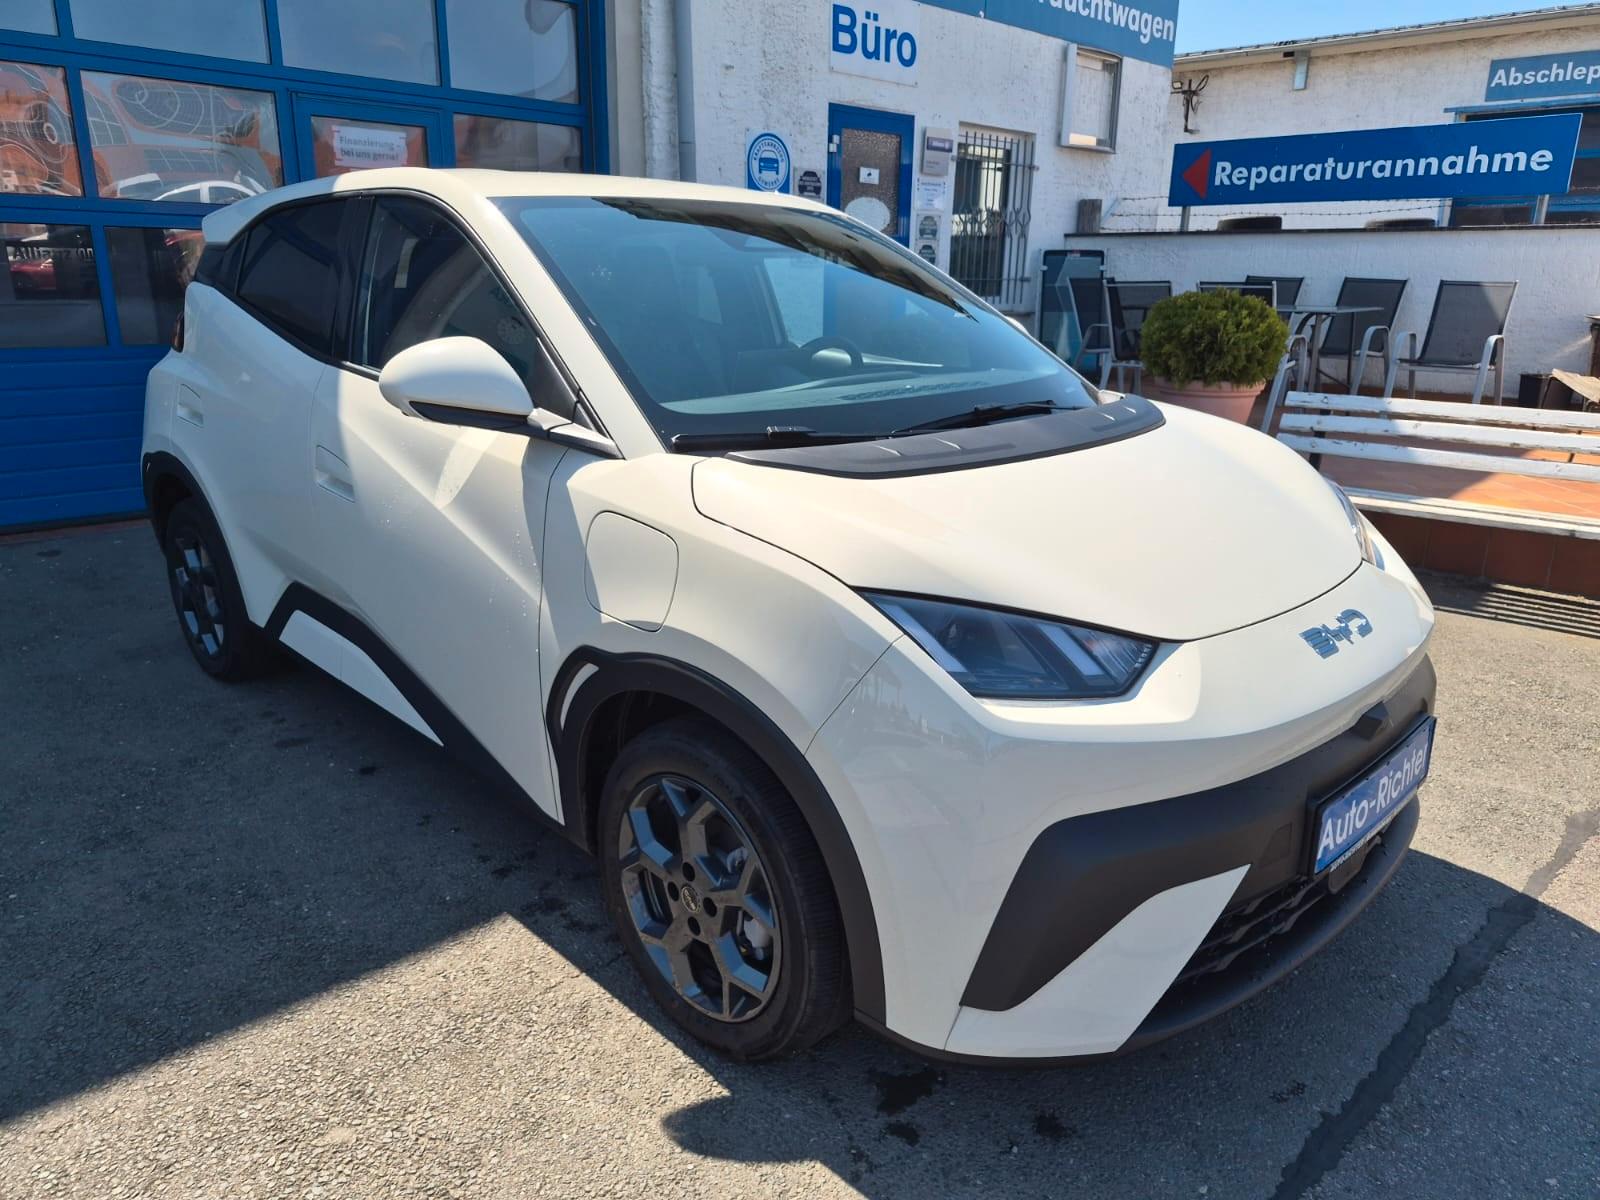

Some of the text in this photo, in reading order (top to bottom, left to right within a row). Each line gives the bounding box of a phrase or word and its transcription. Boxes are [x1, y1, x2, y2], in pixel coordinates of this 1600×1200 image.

[832, 3, 917, 68] Büro
[1214, 145, 1554, 191] Reparaturannahme
[1299, 608, 1373, 660] BYD
[1318, 744, 1429, 860] Auto-Richter
